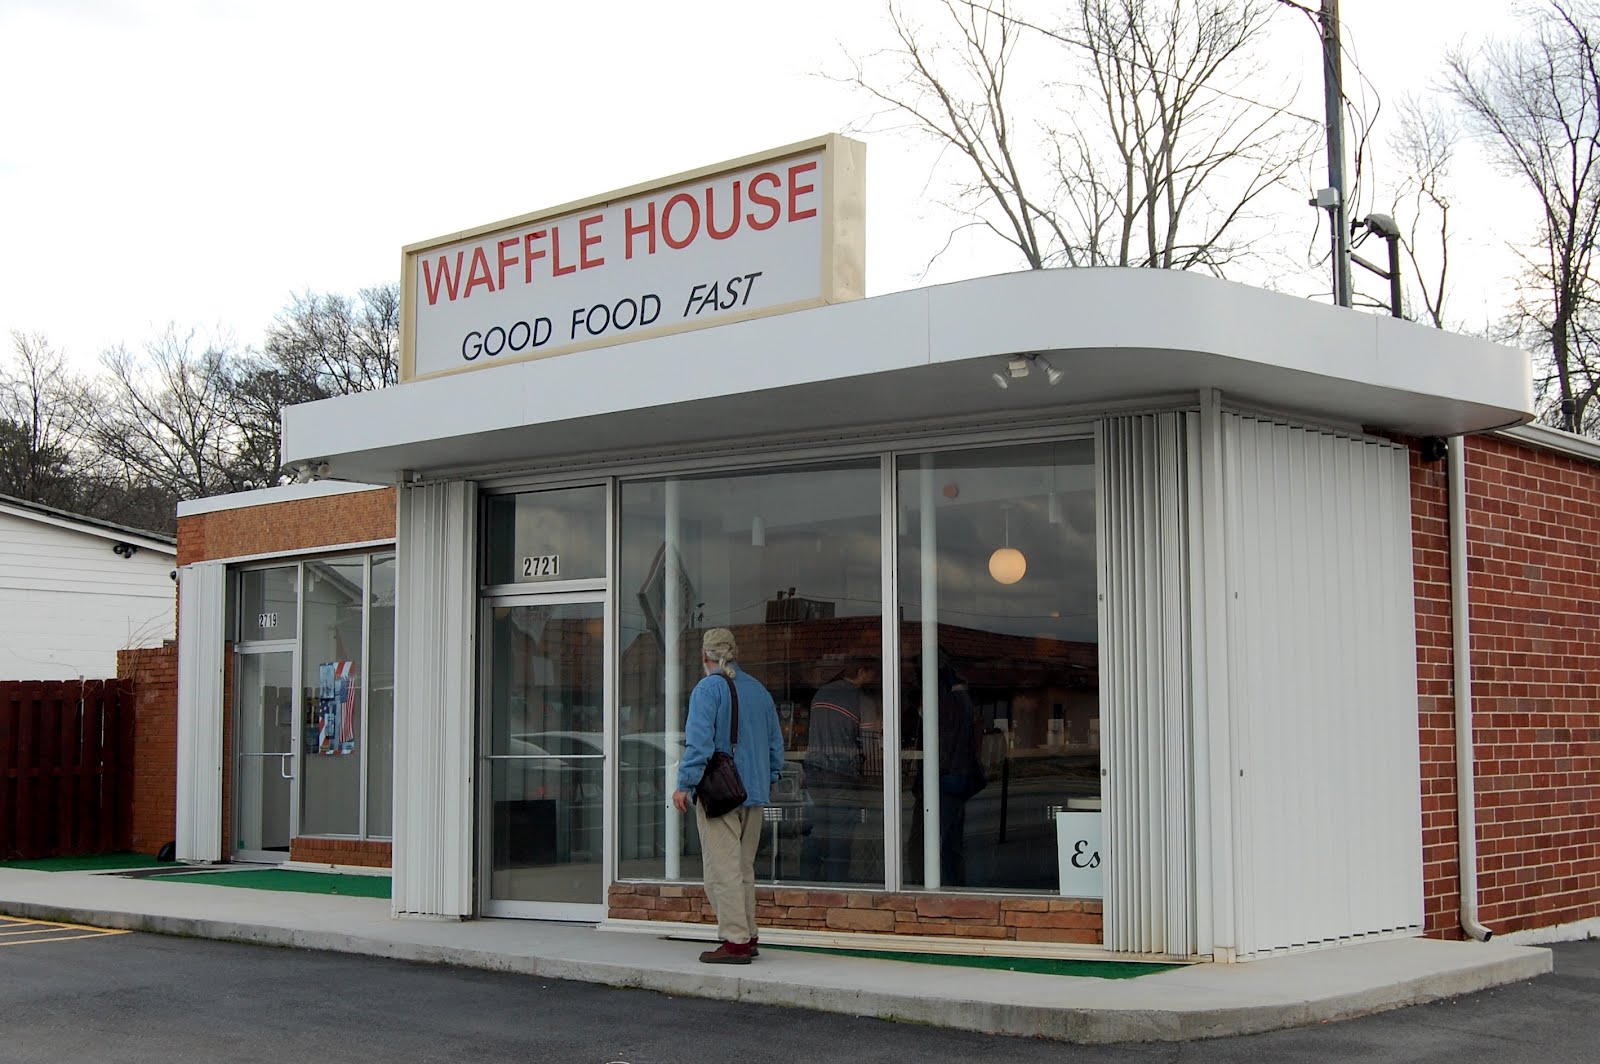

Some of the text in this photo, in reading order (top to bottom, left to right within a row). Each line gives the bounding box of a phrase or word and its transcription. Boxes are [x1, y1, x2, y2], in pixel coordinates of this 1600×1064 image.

[422, 161, 818, 306] WAFFLE HOUSE
[461, 271, 763, 361] GOOD FOOD FAST
[523, 555, 559, 577] 2721
[259, 613, 278, 627] 2719
